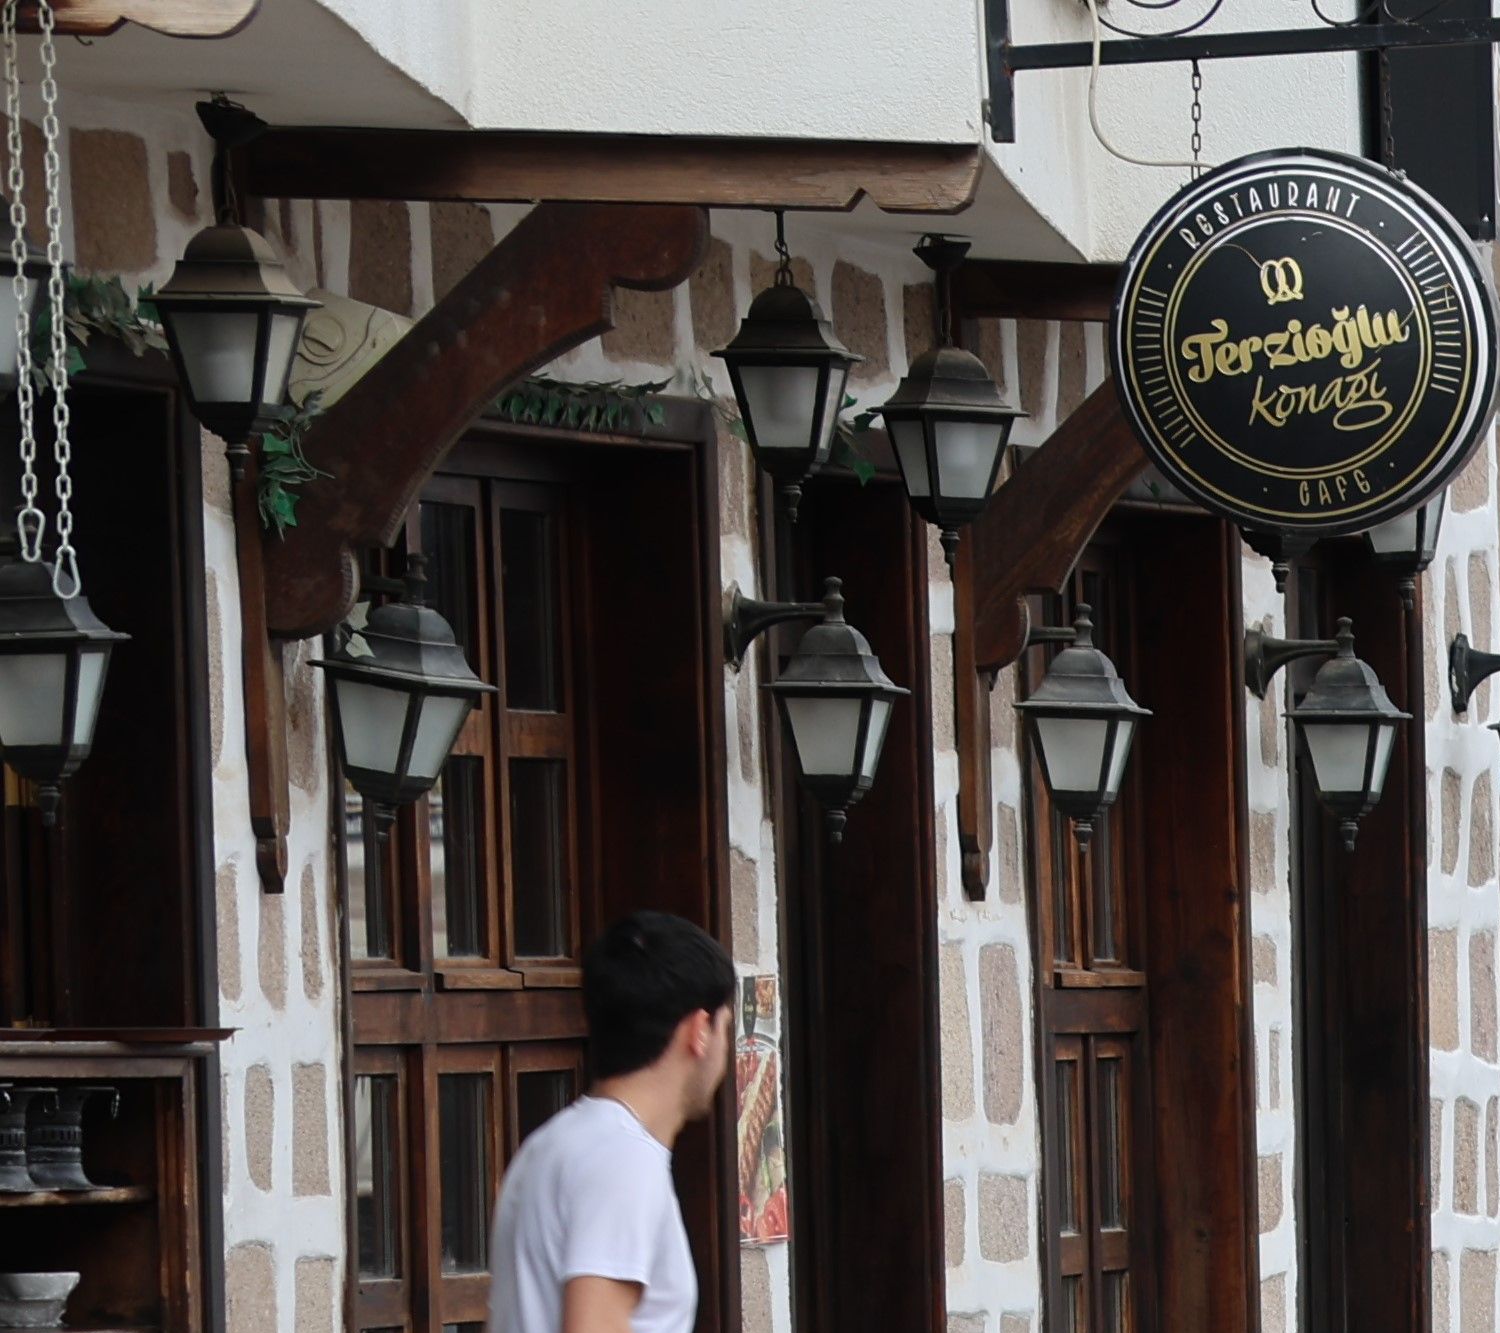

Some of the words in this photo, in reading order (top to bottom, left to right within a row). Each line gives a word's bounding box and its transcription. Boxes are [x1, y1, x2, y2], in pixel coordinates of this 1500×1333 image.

[1179, 181, 1360, 250] RESTAURANT
[1182, 304, 1410, 383] Terzioğlu
[1299, 469, 1371, 506] CAFE
